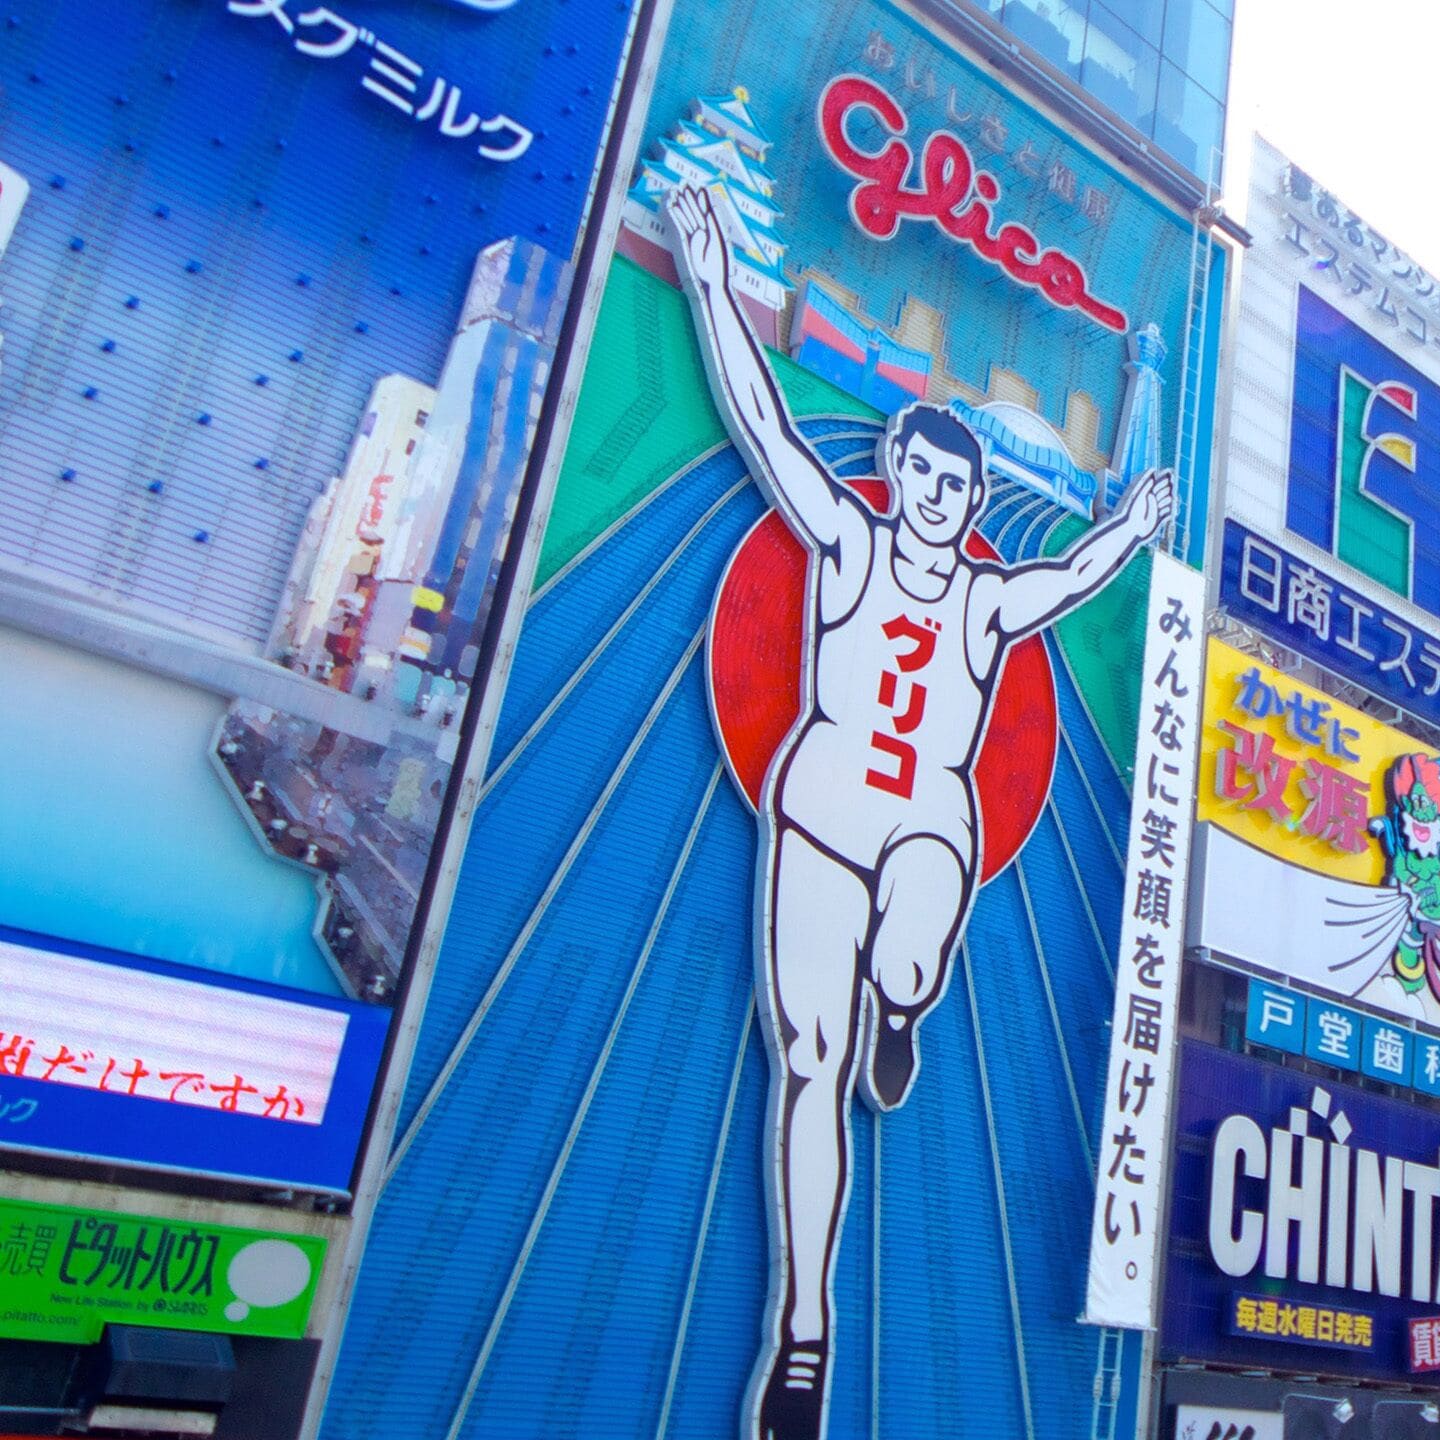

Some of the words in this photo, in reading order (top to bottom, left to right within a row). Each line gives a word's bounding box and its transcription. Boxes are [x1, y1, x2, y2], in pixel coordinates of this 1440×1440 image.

[817, 73, 1130, 335] Glico
[865, 30, 1110, 220] おいしさと健康
[864, 612, 943, 801] グリコ
[1214, 717, 1371, 855] 改源
[1234, 667, 1361, 763] かぜに
[1104, 596, 1194, 1281] みんなに笑顔を届けたい。
[58, 1217, 221, 1297] ピタットハウス
[1235, 1297, 1373, 1348] 毎週水曜日発売
